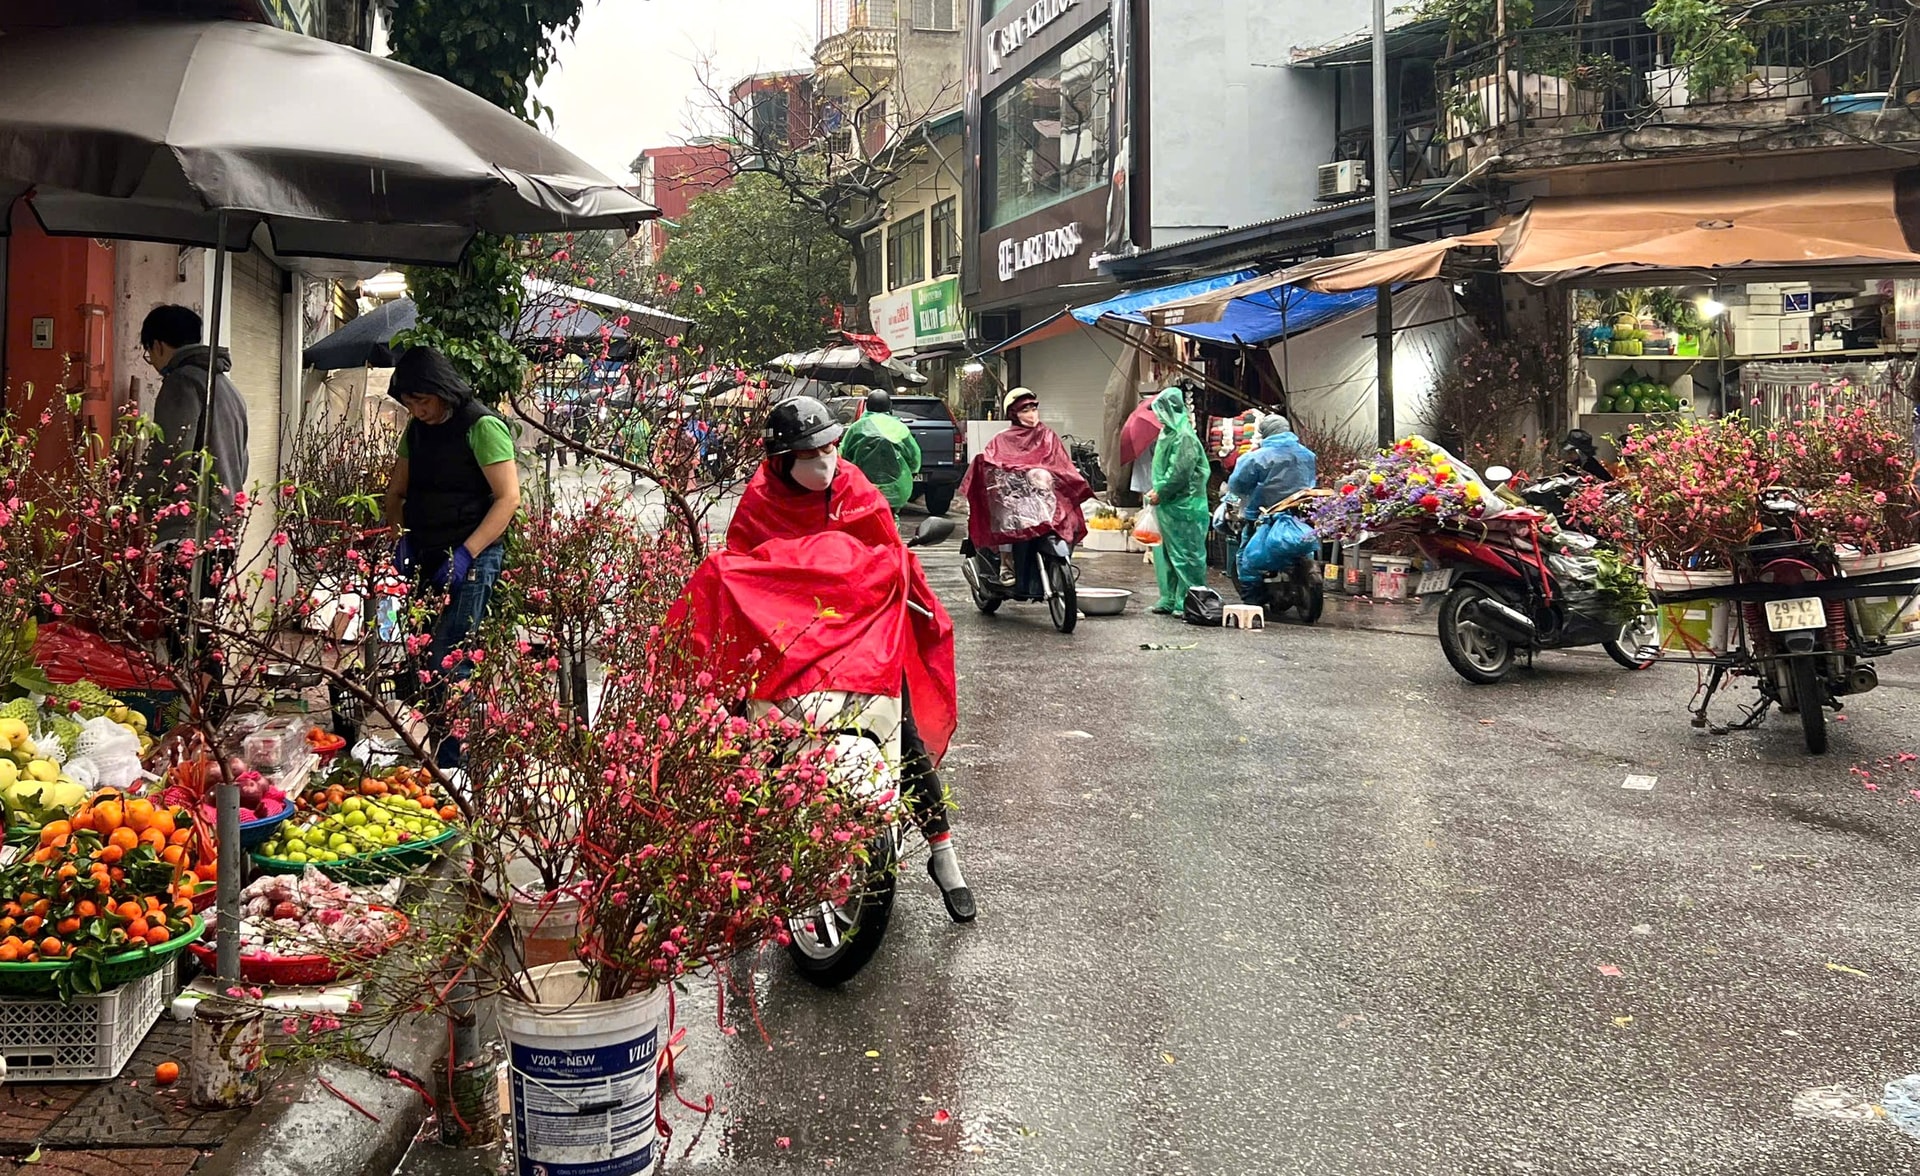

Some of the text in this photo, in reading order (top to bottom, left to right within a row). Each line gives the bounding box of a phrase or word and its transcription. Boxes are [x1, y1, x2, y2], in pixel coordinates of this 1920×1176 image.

[1045, 222, 1082, 262] BOSS
[531, 1054, 556, 1067] V204
[567, 1054, 595, 1067] NEW
